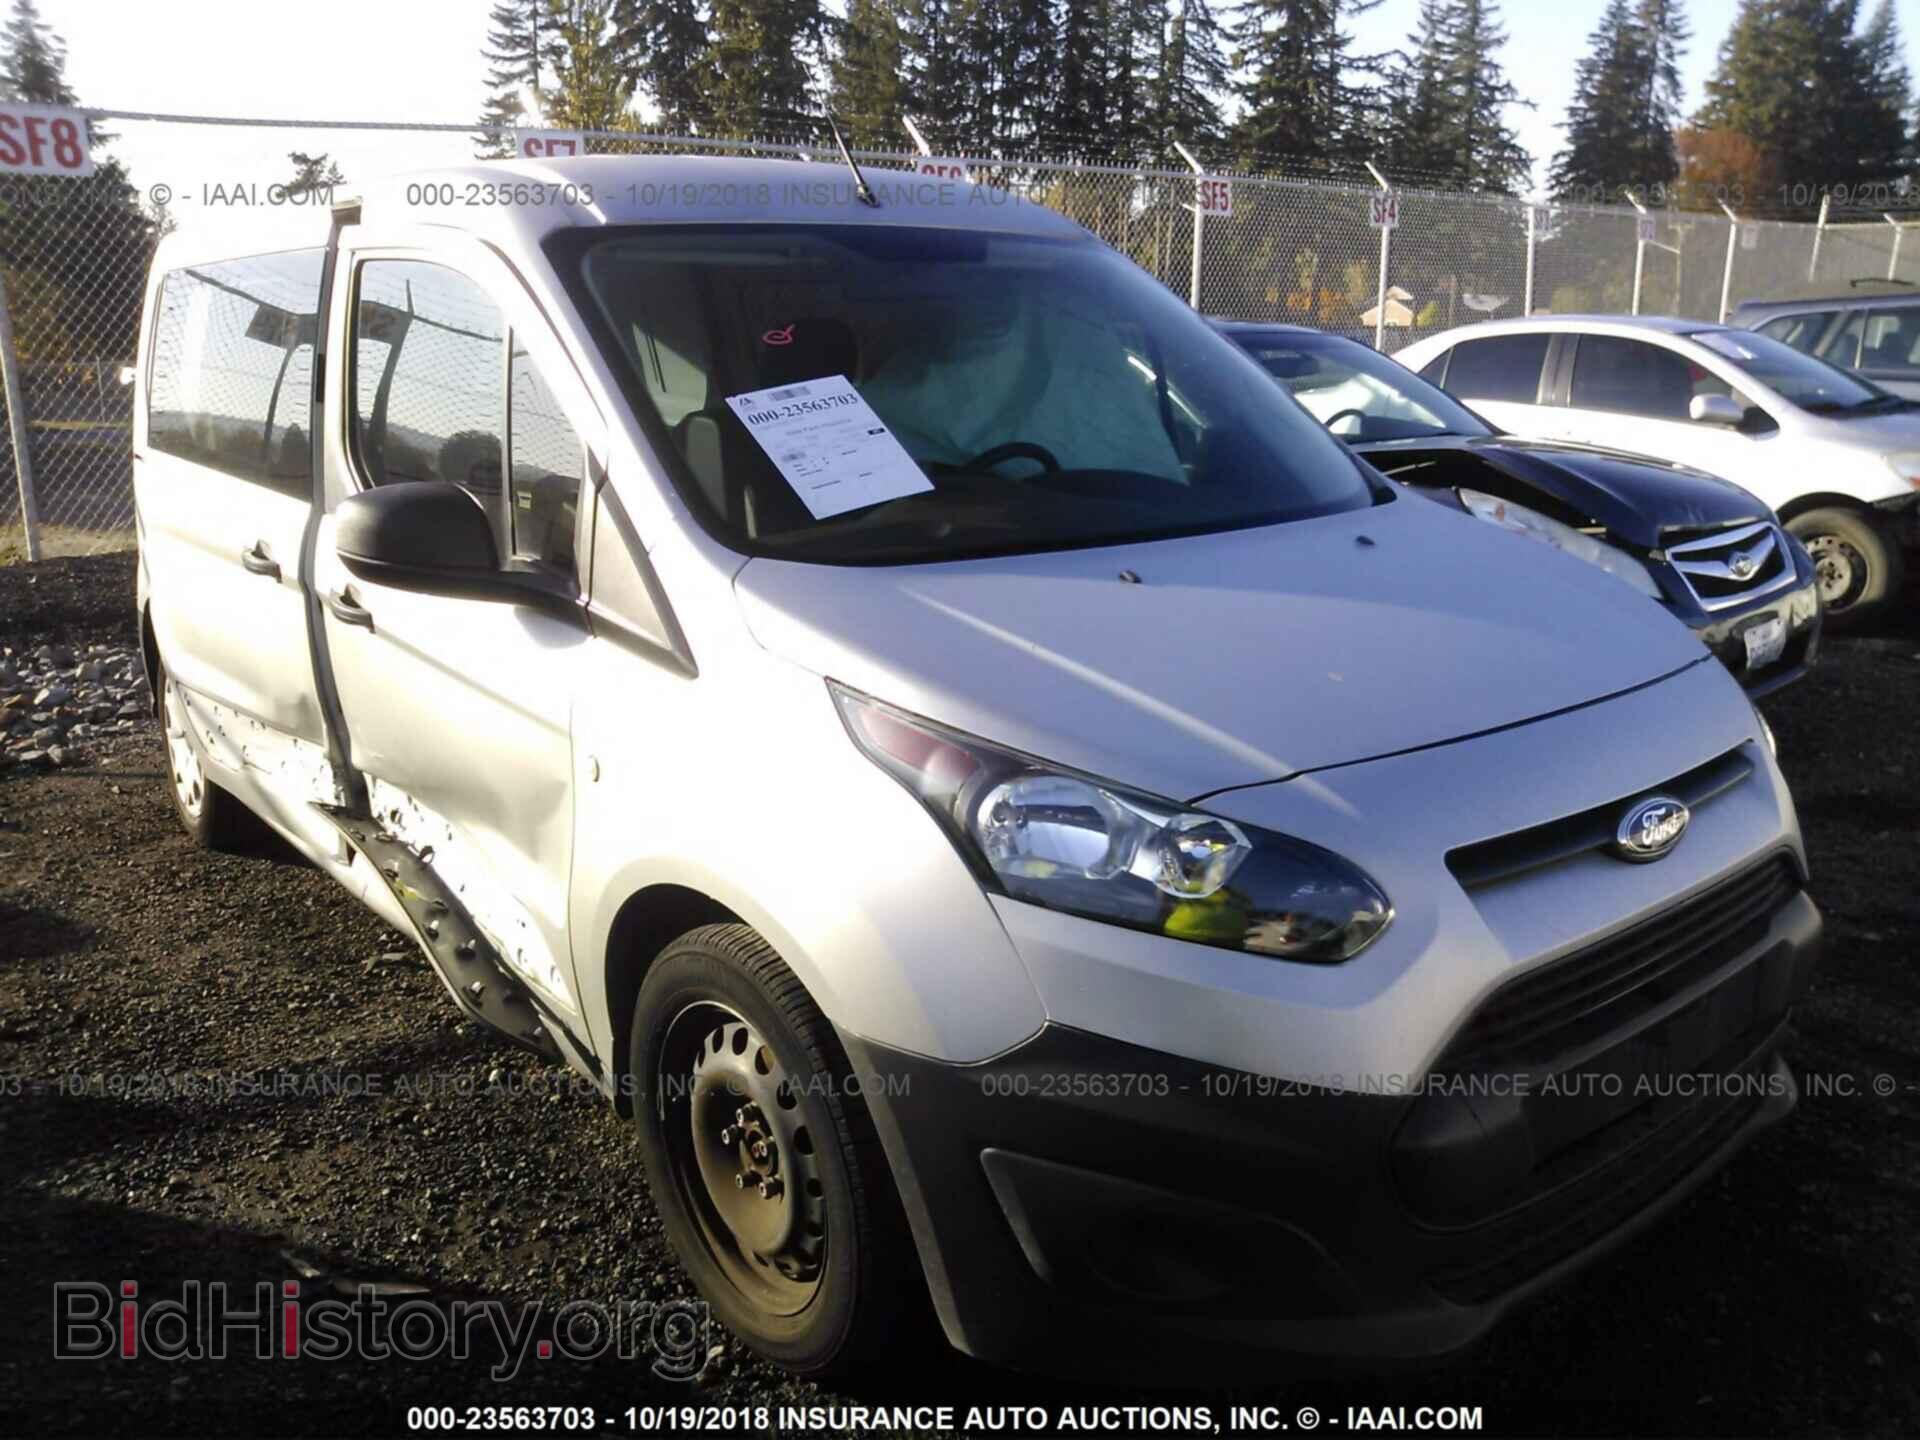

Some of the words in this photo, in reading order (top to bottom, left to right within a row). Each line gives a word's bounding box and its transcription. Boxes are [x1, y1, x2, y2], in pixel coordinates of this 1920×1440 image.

[0, 114, 82, 168] SF8
[1201, 180, 1229, 211] SF5
[1373, 200, 1396, 223] SF4
[748, 393, 858, 425] 000-23563703
[1642, 807, 1685, 845] Ford
